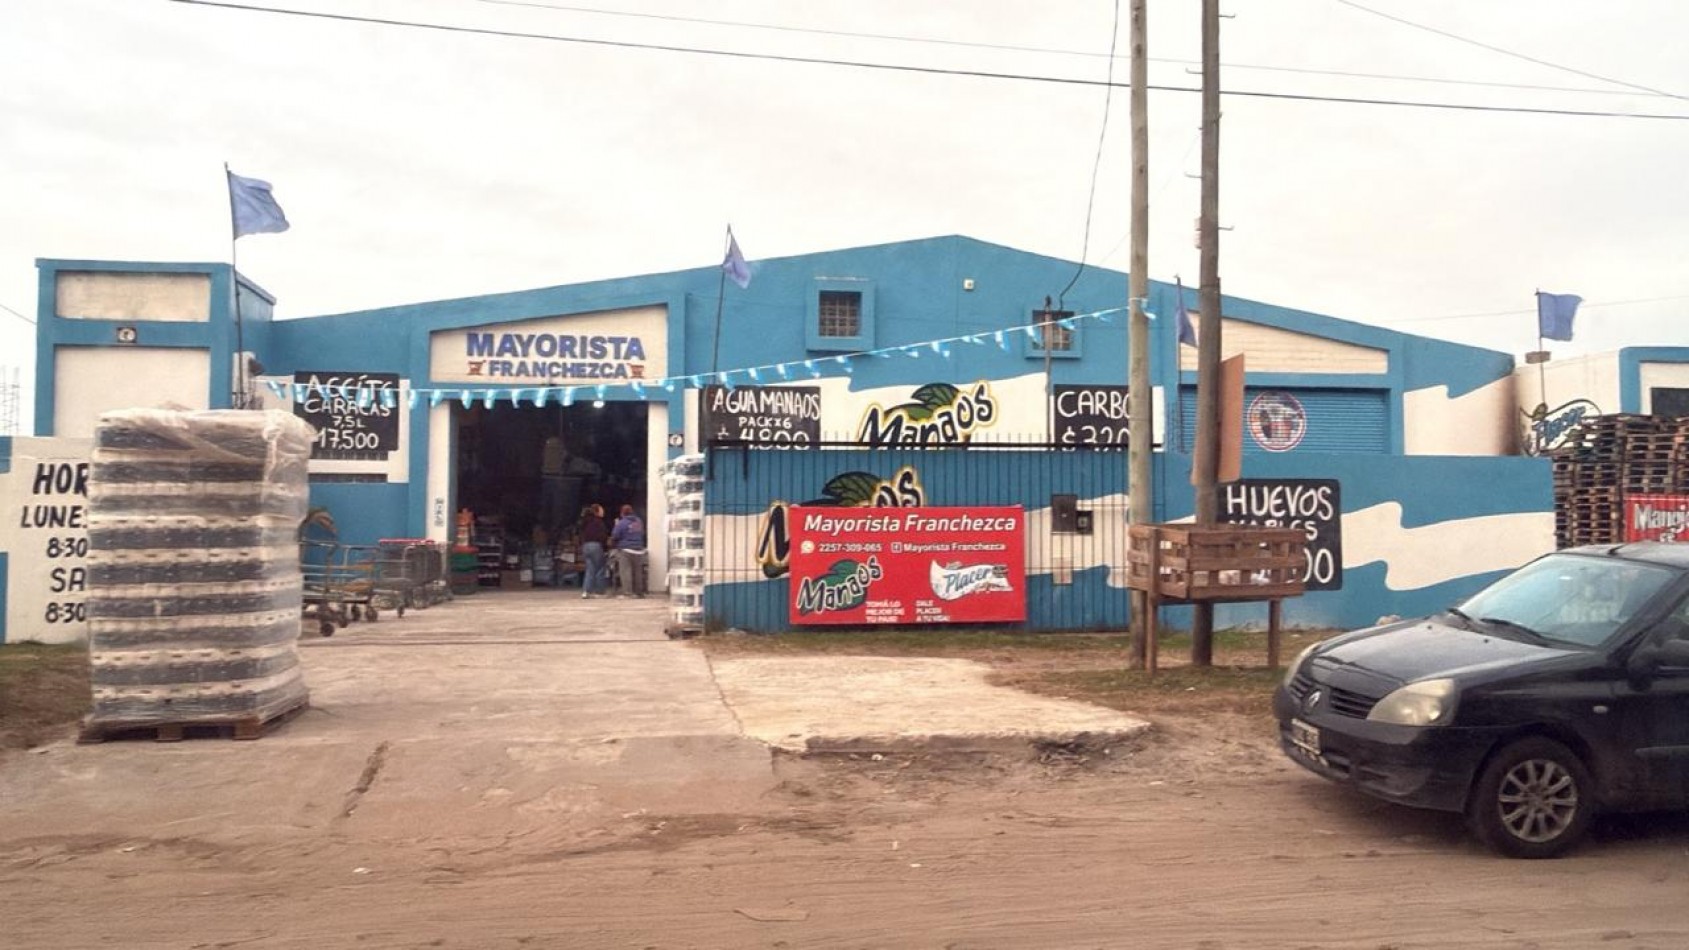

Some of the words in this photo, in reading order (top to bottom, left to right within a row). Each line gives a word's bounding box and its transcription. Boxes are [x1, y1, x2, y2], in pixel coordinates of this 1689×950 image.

[467, 333, 645, 360] MAYORISTA
[489, 360, 628, 379] FRANCHEZCA
[712, 388, 758, 413] AGUA
[760, 389, 820, 420] MANAOS
[859, 384, 992, 450] Manaos
[1226, 485, 1334, 520] HUEVOS
[21, 505, 87, 528] LUNE
[804, 514, 900, 536] Mayorista
[904, 514, 1016, 531] Franchezca
[903, 543, 950, 552] Mayorista
[951, 542, 1006, 551] Franchezca
[797, 557, 882, 613] Manaos
